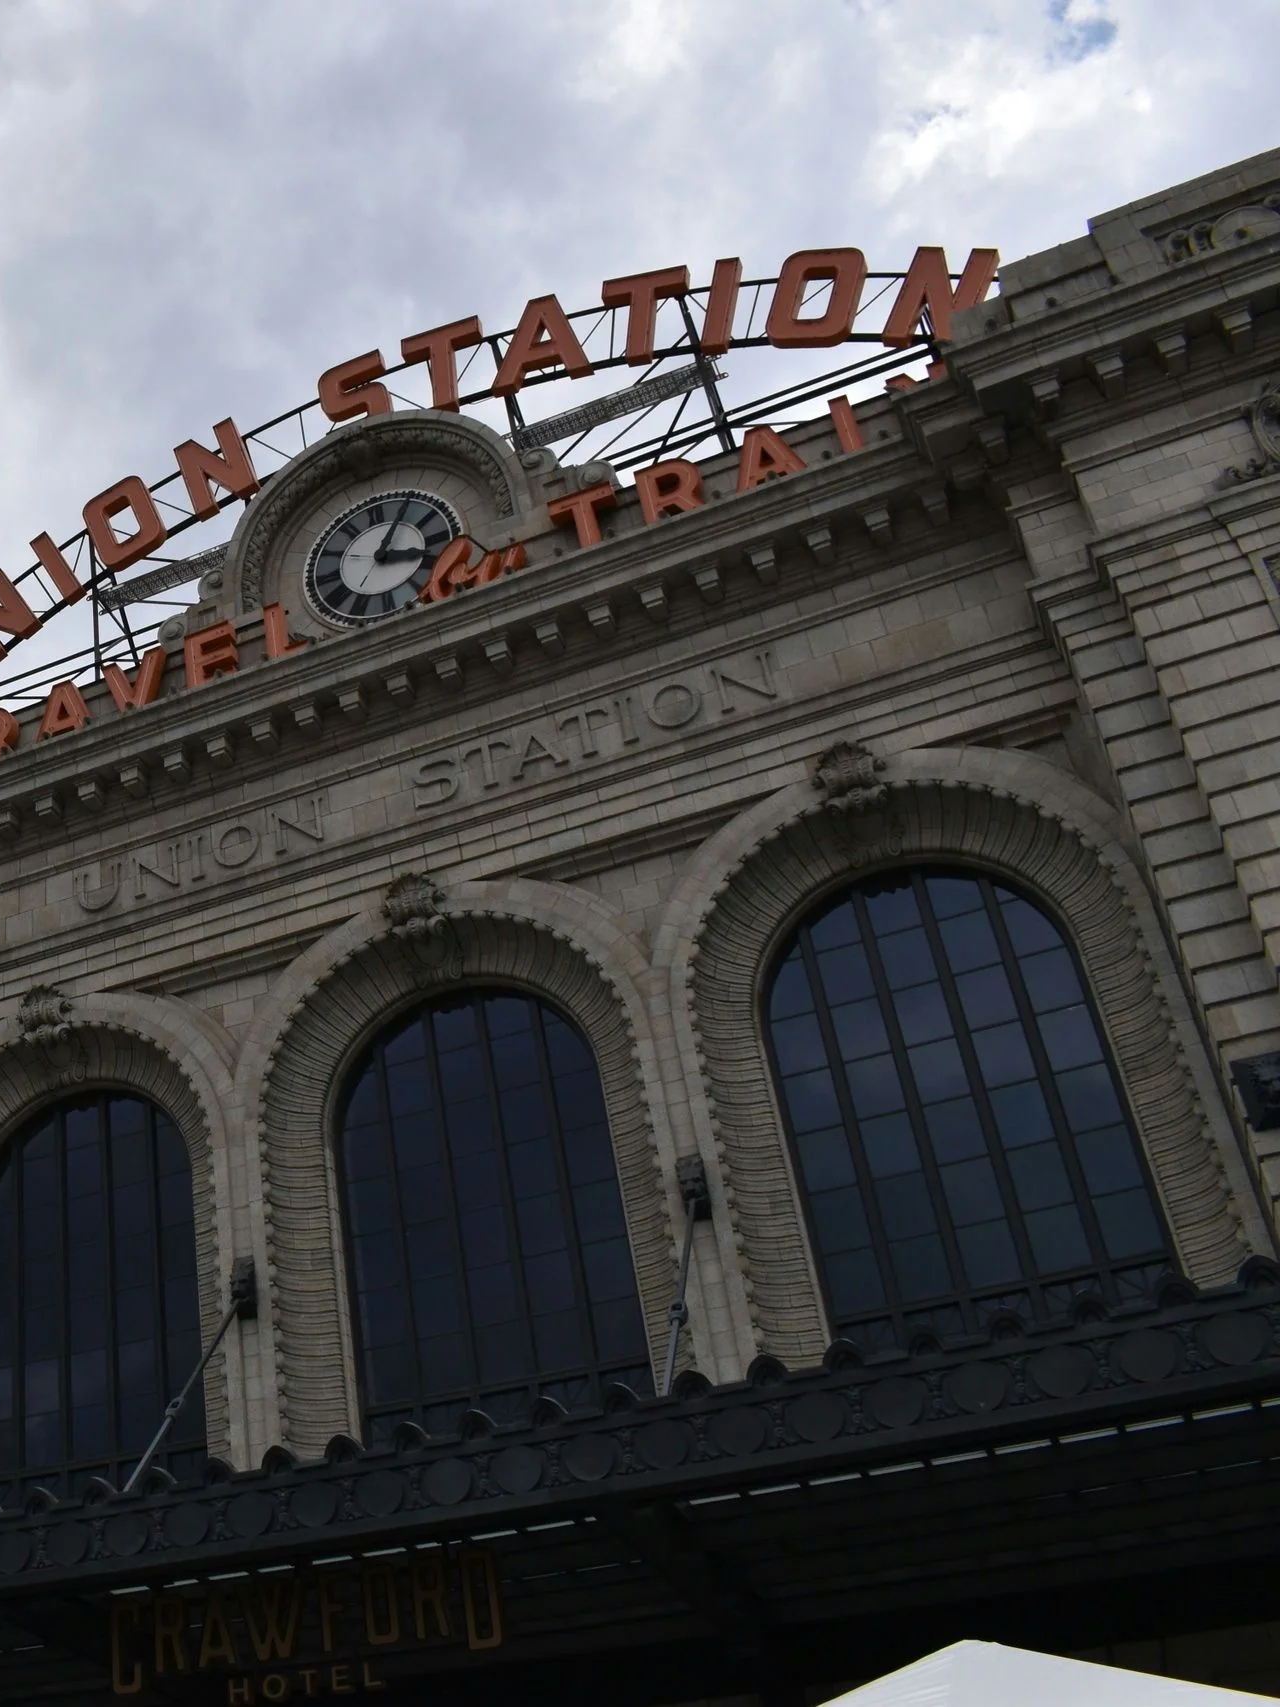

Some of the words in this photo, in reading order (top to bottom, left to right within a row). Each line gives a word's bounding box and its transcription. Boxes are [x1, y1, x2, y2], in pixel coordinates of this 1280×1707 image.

[318, 246, 1001, 422] STATION
[547, 361, 949, 549] TRAI
[74, 797, 325, 913] UNION
[412, 651, 778, 808] STATION
[110, 1547, 504, 1696] CRAWFORD
[227, 1660, 385, 1707] HOTEL
